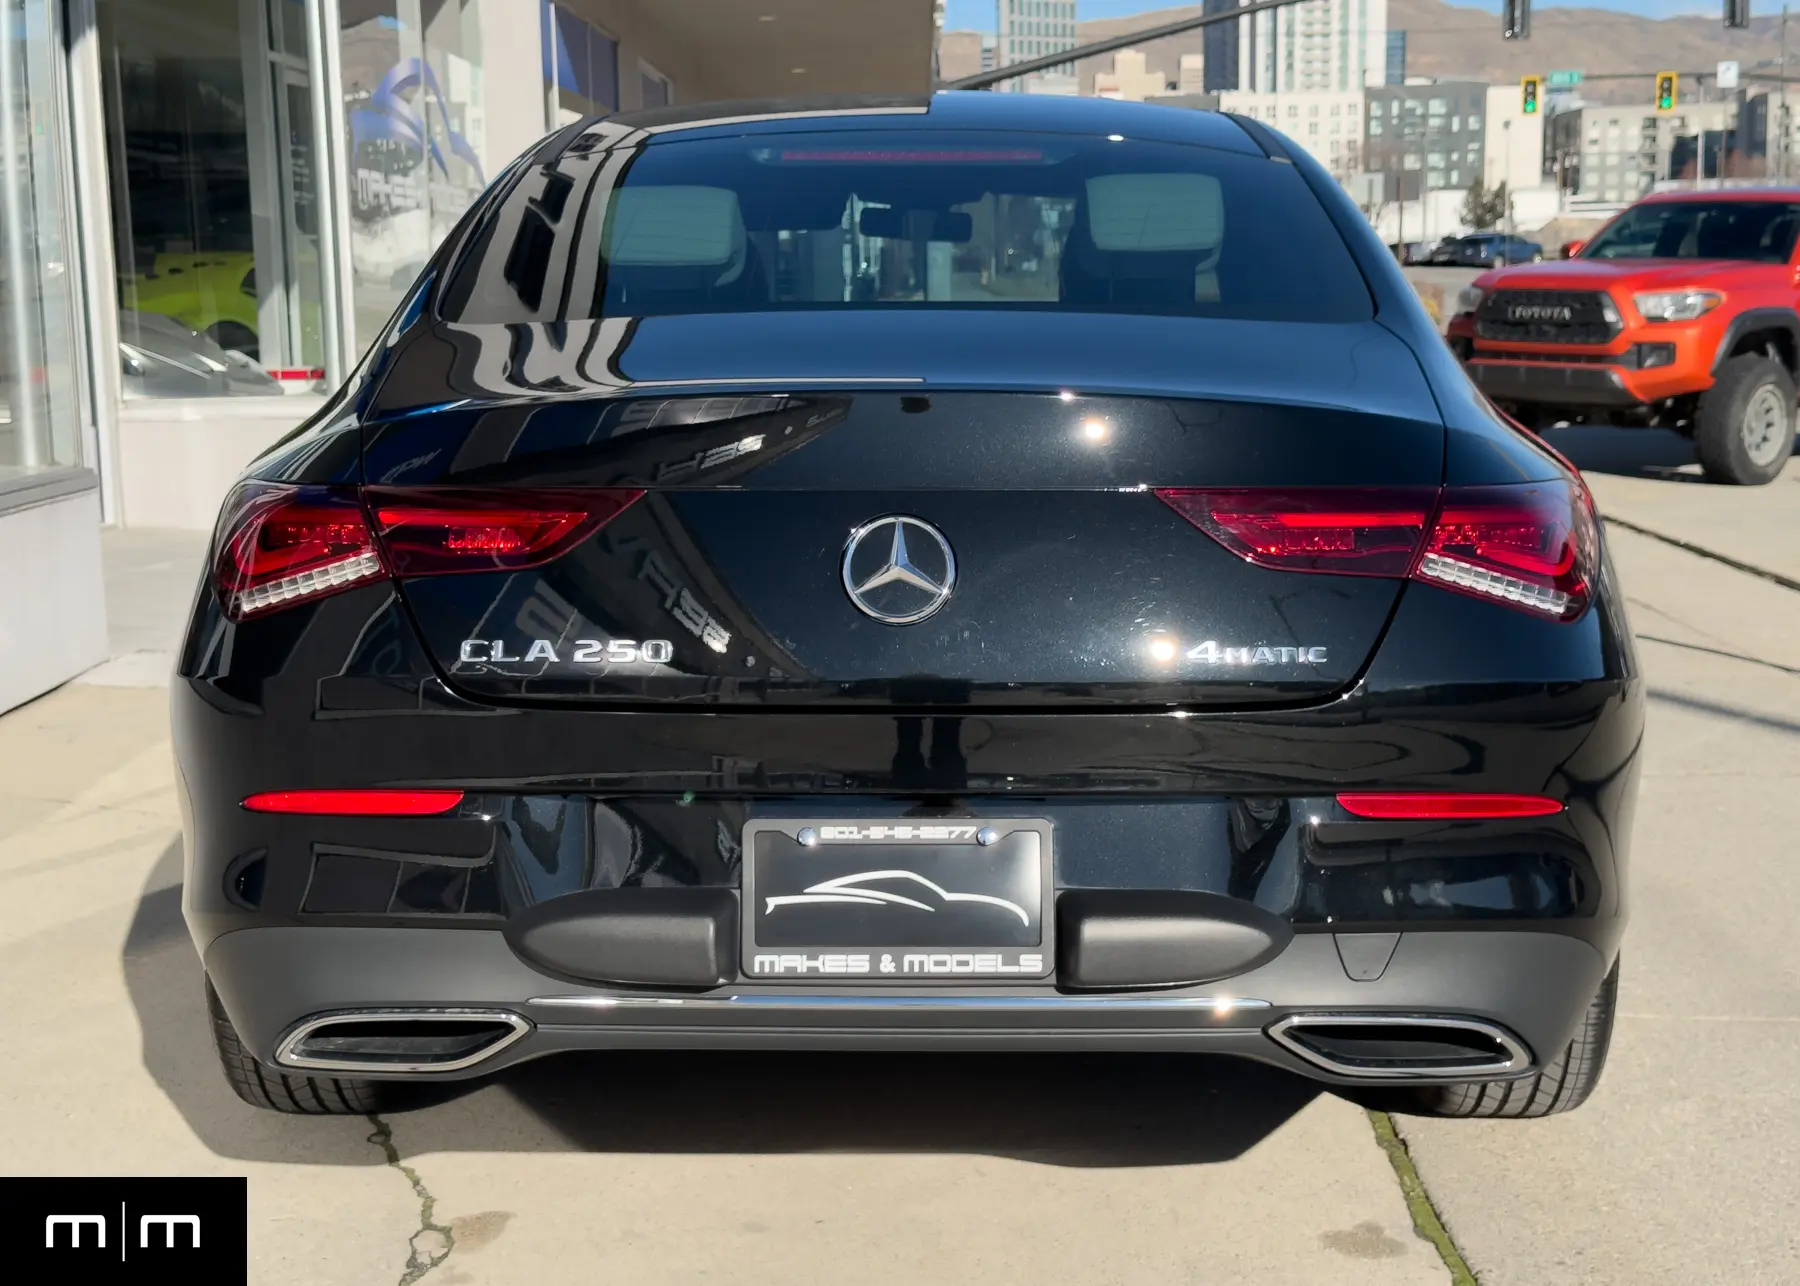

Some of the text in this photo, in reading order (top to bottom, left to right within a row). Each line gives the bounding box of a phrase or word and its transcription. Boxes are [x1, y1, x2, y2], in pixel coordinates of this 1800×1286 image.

[1514, 305, 1571, 320] TOYOTA
[460, 639, 673, 663] CLA 250
[1186, 640, 1328, 664] 4MATIC
[754, 953, 1043, 973] MAKES & MODELS
